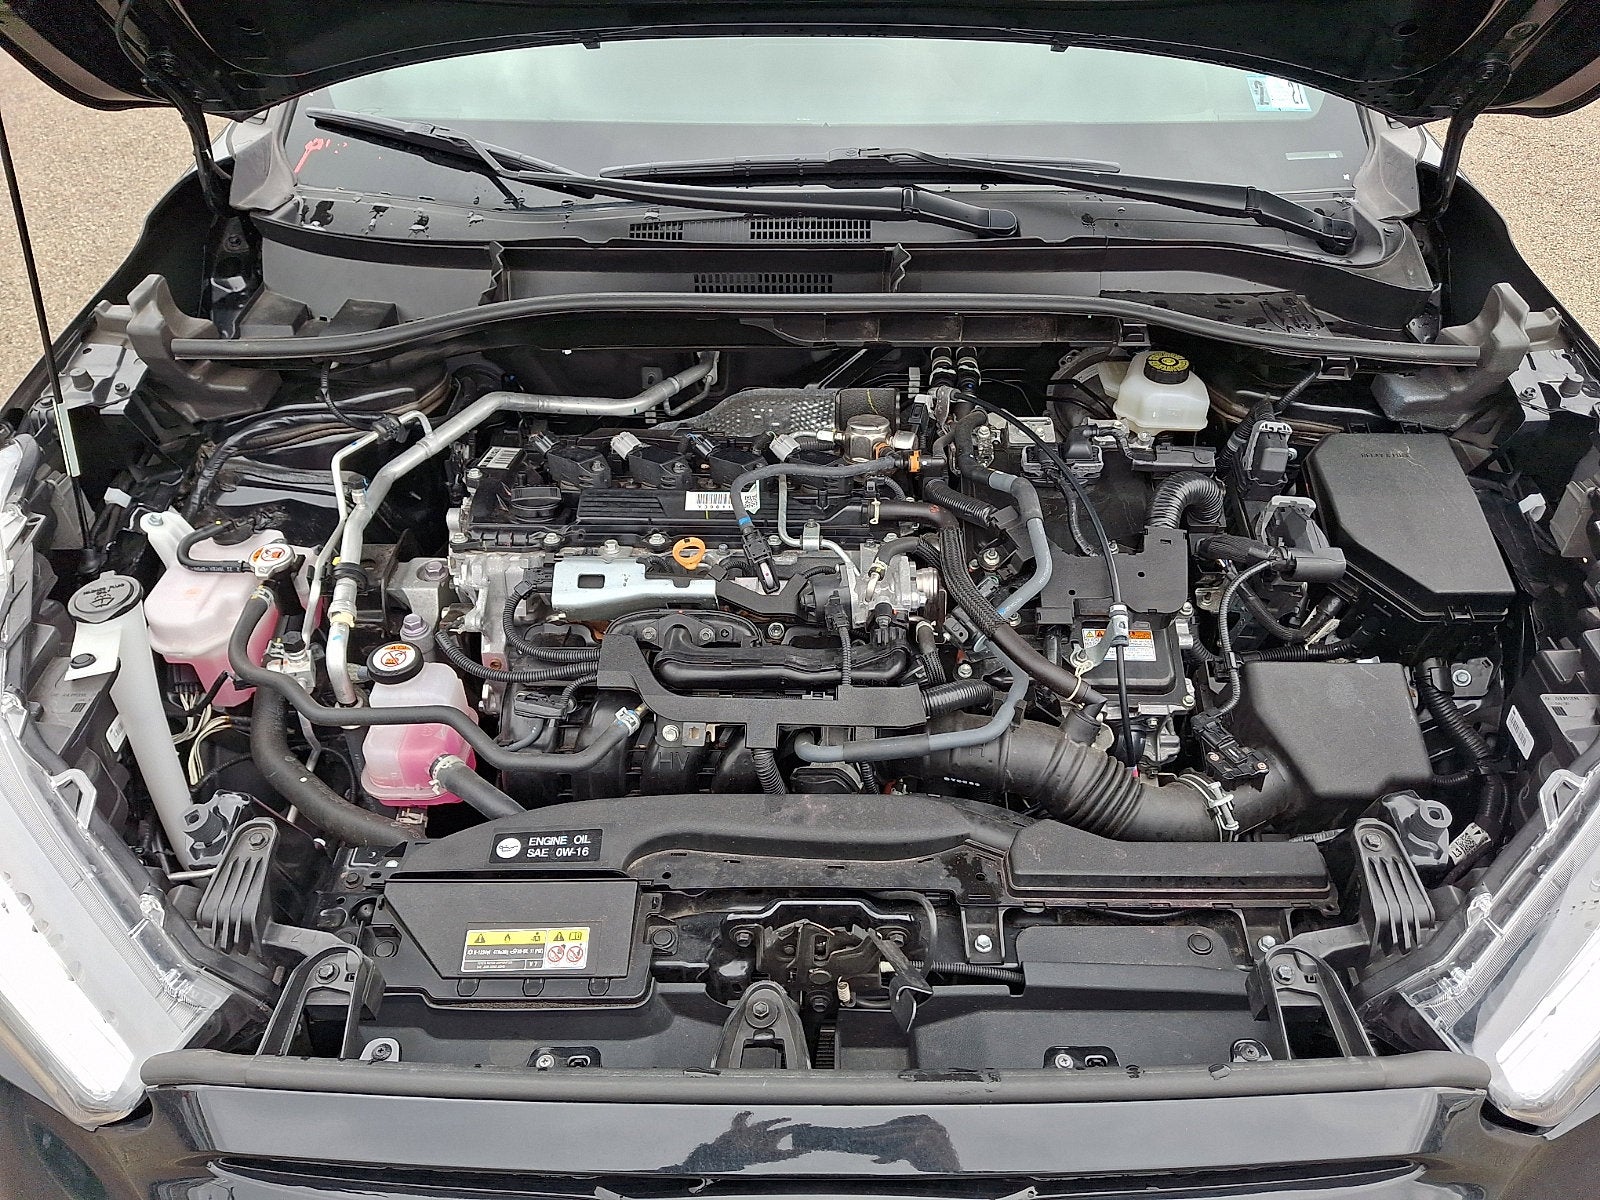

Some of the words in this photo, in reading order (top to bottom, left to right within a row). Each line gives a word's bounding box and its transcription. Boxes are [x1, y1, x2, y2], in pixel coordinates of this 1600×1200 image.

[528, 835, 568, 847] ENGINE
[573, 834, 592, 845] OIL
[526, 848, 549, 858] SAE
[555, 846, 590, 857] 0W-16
